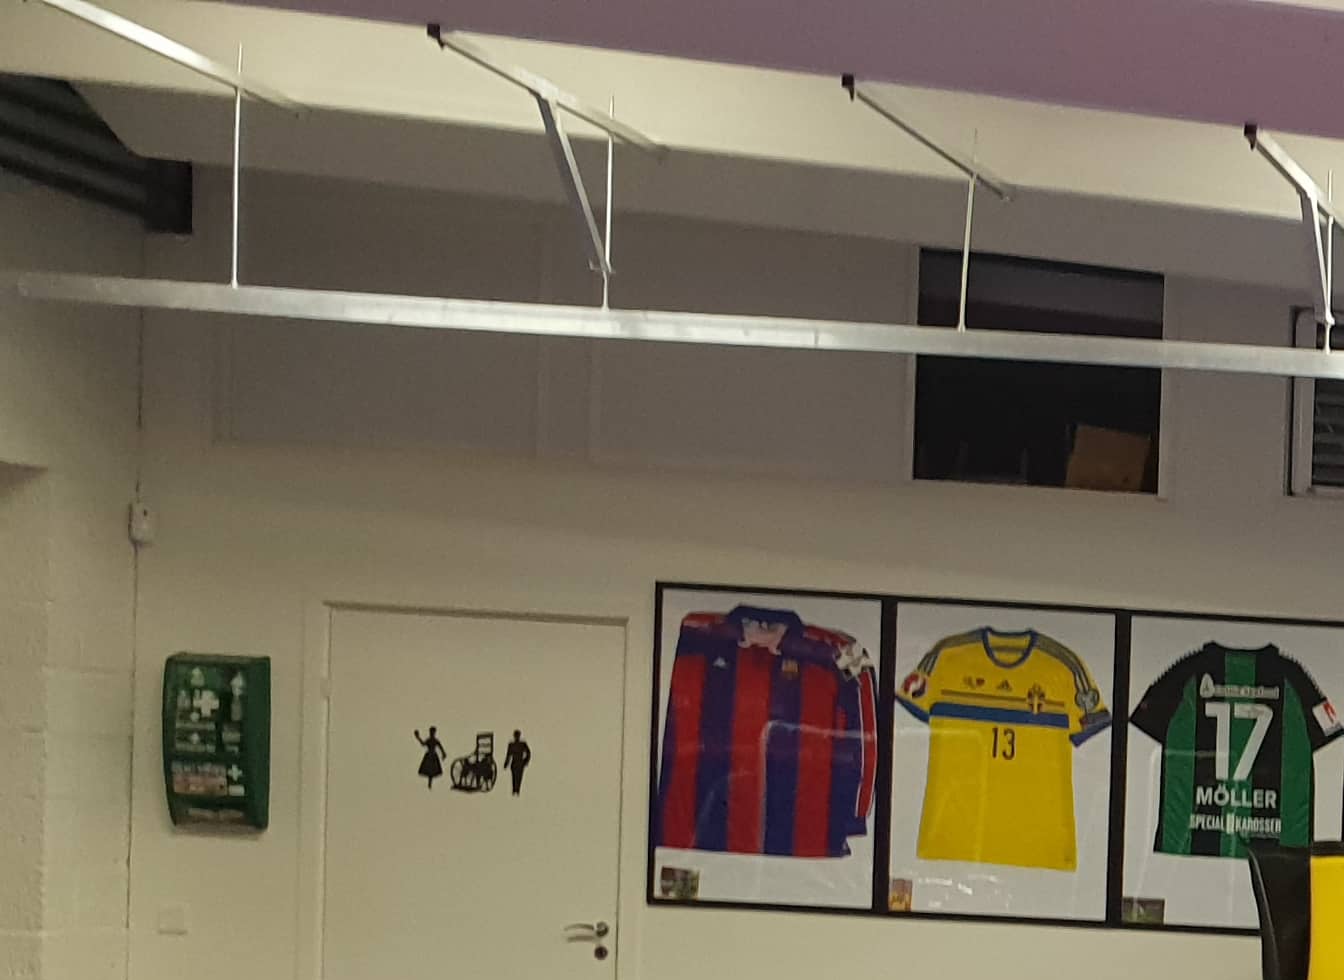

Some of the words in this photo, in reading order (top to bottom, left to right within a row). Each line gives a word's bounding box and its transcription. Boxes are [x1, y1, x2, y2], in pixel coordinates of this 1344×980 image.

[992, 727, 1016, 760] 13
[1205, 702, 1274, 781] 17
[1196, 784, 1277, 808] MÖLLER
[1190, 814, 1224, 831] SPECIAL
